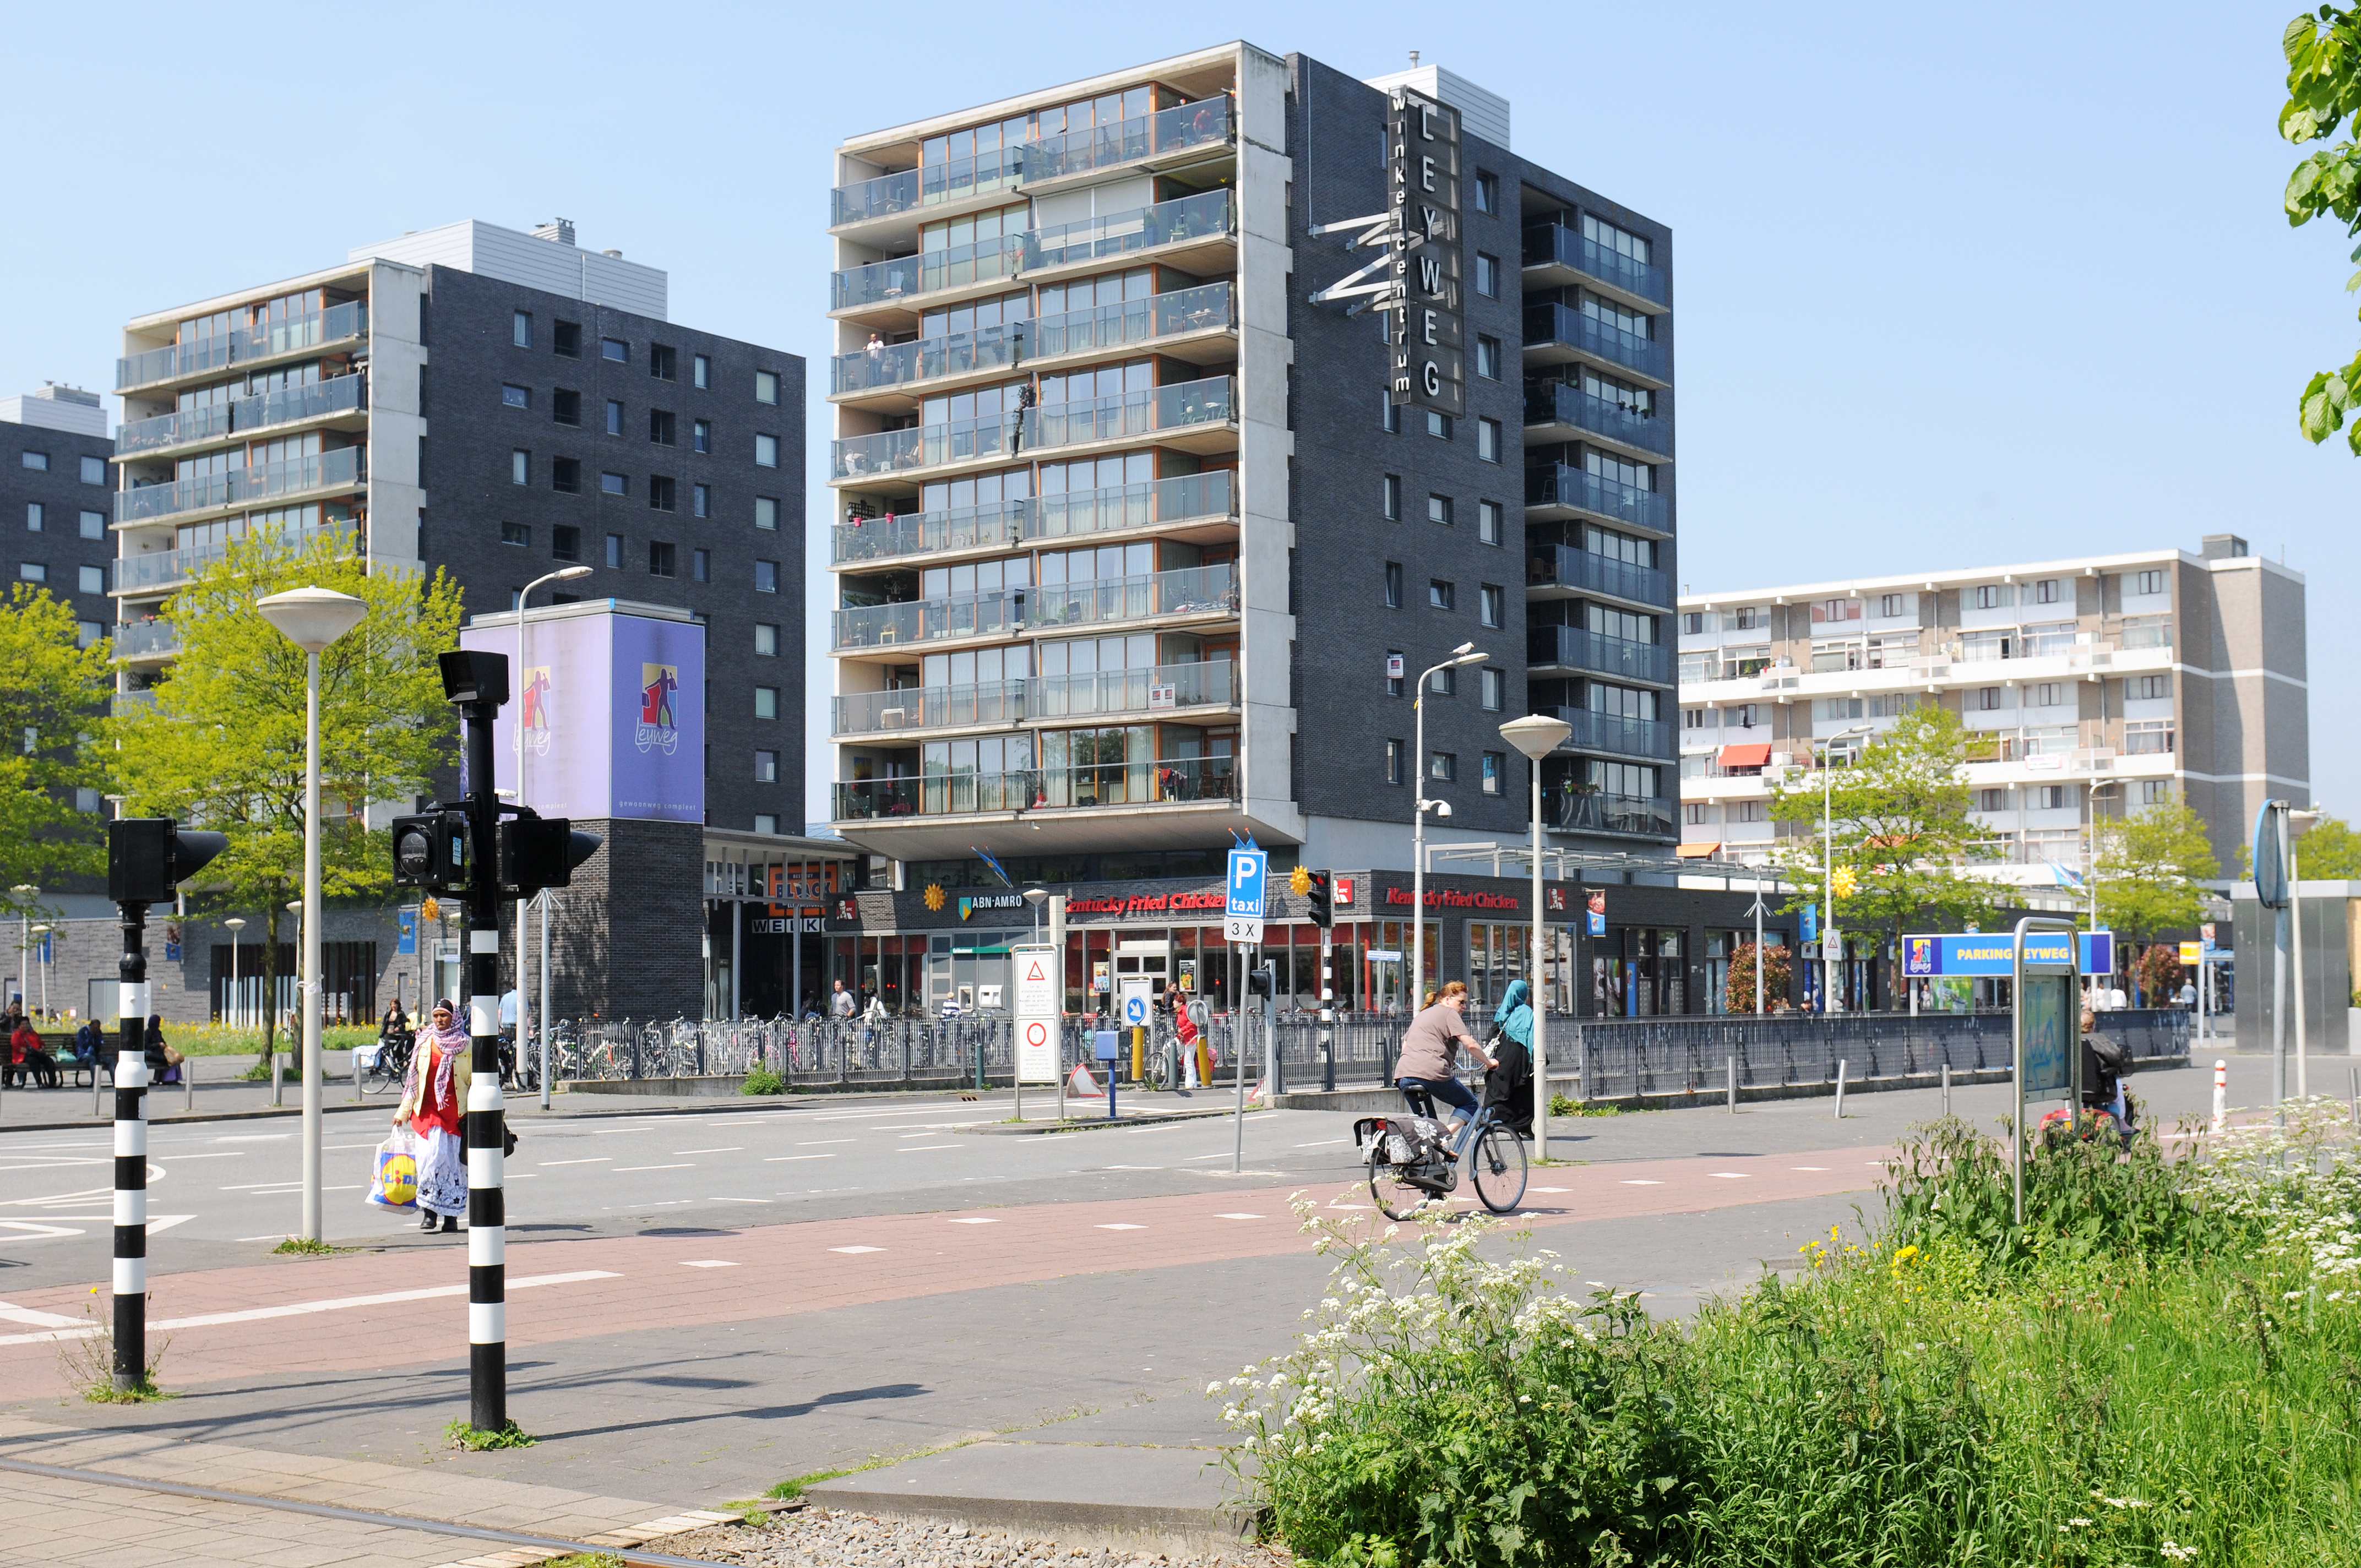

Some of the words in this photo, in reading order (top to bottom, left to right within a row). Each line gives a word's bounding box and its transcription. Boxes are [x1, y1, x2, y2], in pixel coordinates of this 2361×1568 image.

[1392, 96, 1410, 391] winkelcentrum
[1419, 104, 1440, 397] LEYWEG
[513, 723, 551, 756] Lyweg
[635, 717, 678, 755] Leyweg
[619, 800, 661, 809] gewoonweg
[664, 802, 697, 811] compleet
[1236, 856, 1257, 889] P
[1065, 896, 1127, 915] entucky
[1127, 894, 1168, 911] Fried
[1231, 897, 1259, 912] taxi
[1444, 890, 1474, 907] Fried
[1475, 891, 1518, 909] Chicken
[1231, 923, 1239, 935] 3
[1957, 948, 2014, 960] PARKING
[2024, 947, 2069, 960] EYWEG
